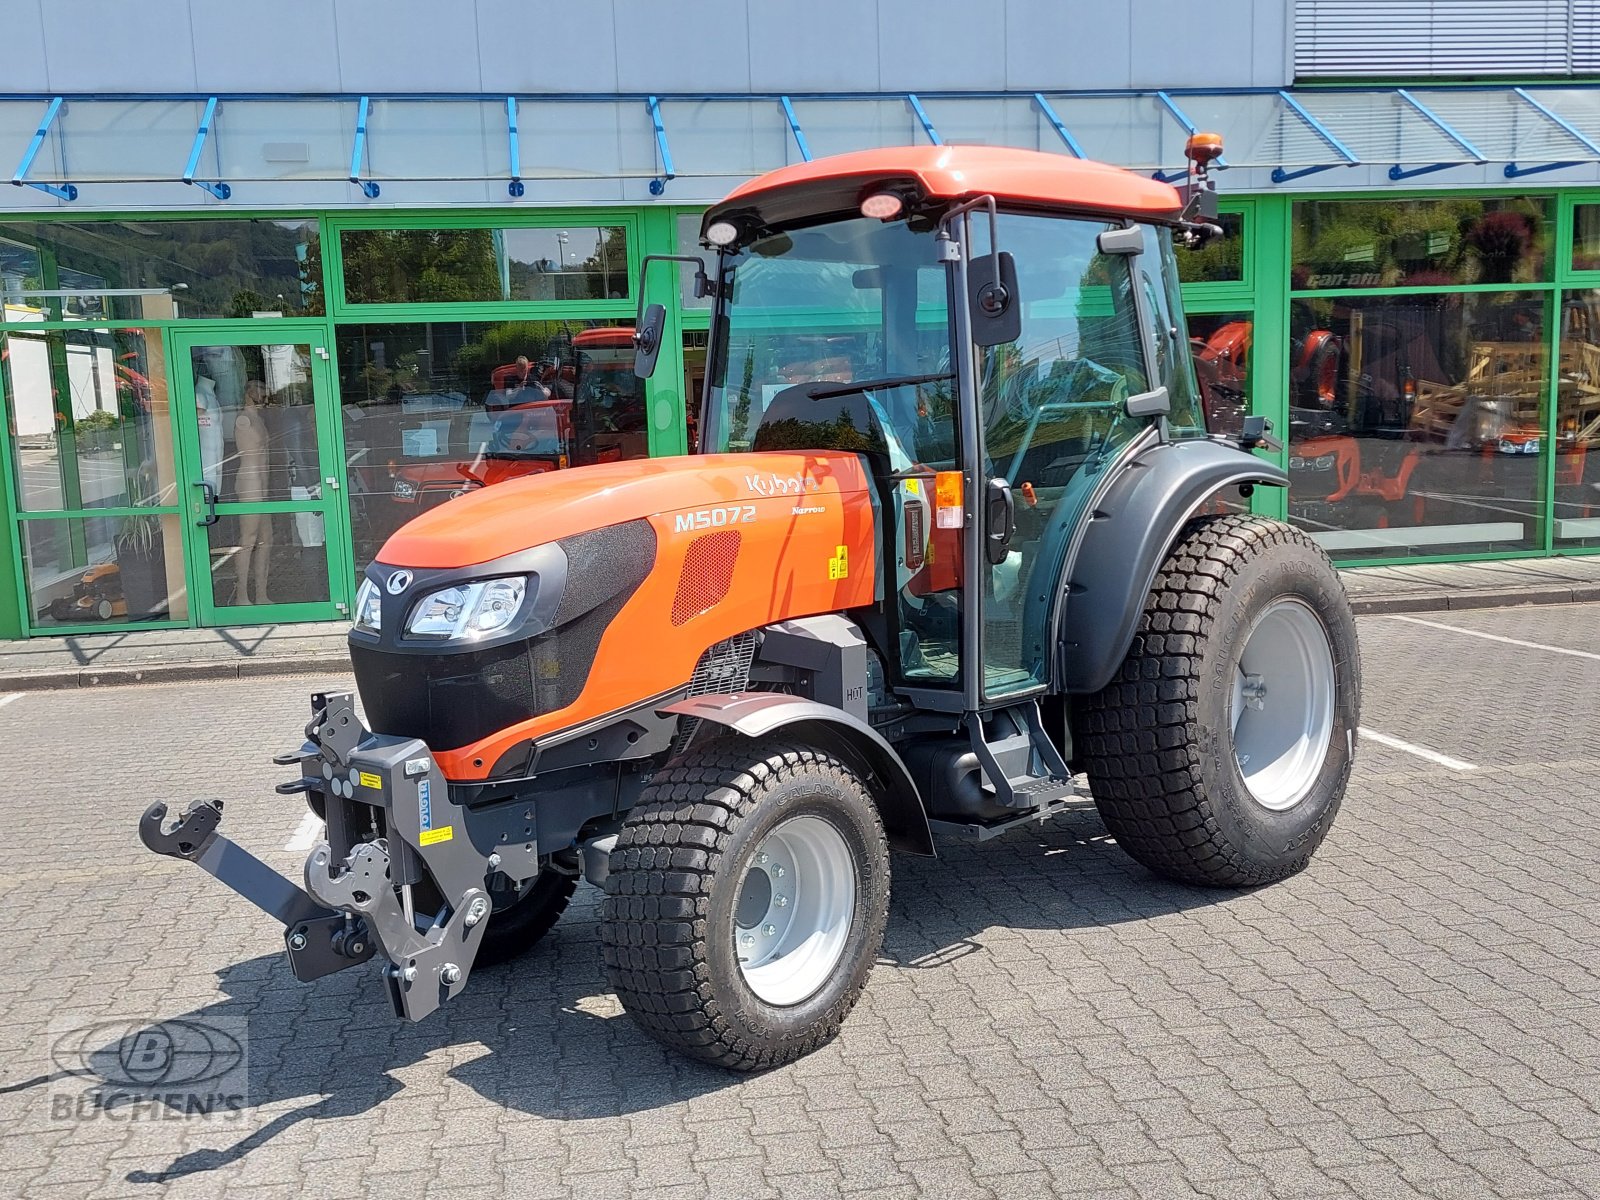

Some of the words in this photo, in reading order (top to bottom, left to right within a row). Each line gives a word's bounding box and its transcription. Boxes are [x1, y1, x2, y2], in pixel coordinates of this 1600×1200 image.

[1306, 272, 1380, 287] can-am
[745, 472, 819, 496] Kubota
[674, 505, 756, 533] M5072
[791, 506, 826, 515] Narrow
[846, 686, 863, 701] HOT
[776, 783, 846, 806] GALAXY
